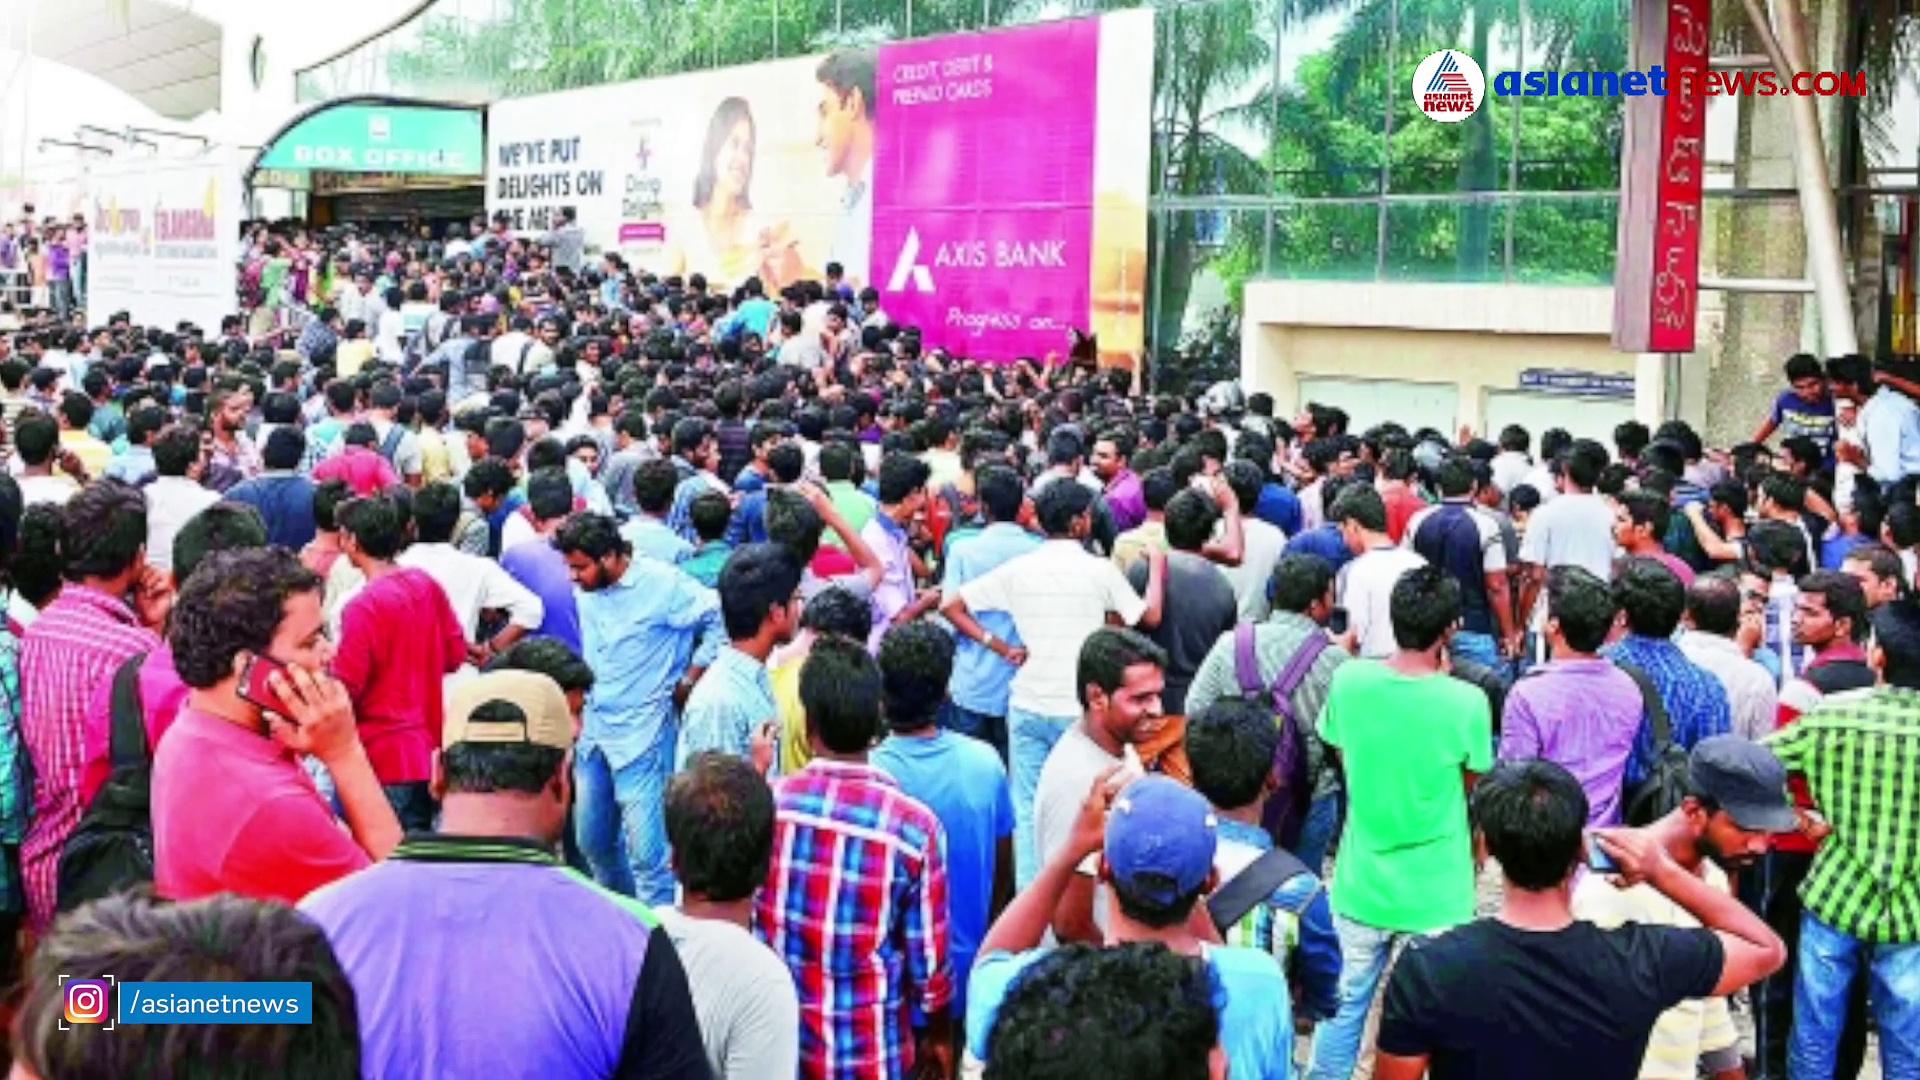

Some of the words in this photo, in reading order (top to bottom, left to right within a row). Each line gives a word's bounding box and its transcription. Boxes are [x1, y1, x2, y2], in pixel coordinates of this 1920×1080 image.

[945, 78, 993, 101] CARDS
[294, 146, 354, 164] BOX
[364, 149, 467, 167] OFFICE
[550, 135, 581, 163] PUT
[498, 171, 571, 199] DELIGHTS
[576, 170, 605, 196] ON
[934, 240, 986, 268] AXIS
[995, 239, 1067, 268] BANK
[945, 307, 1022, 338] Progress
